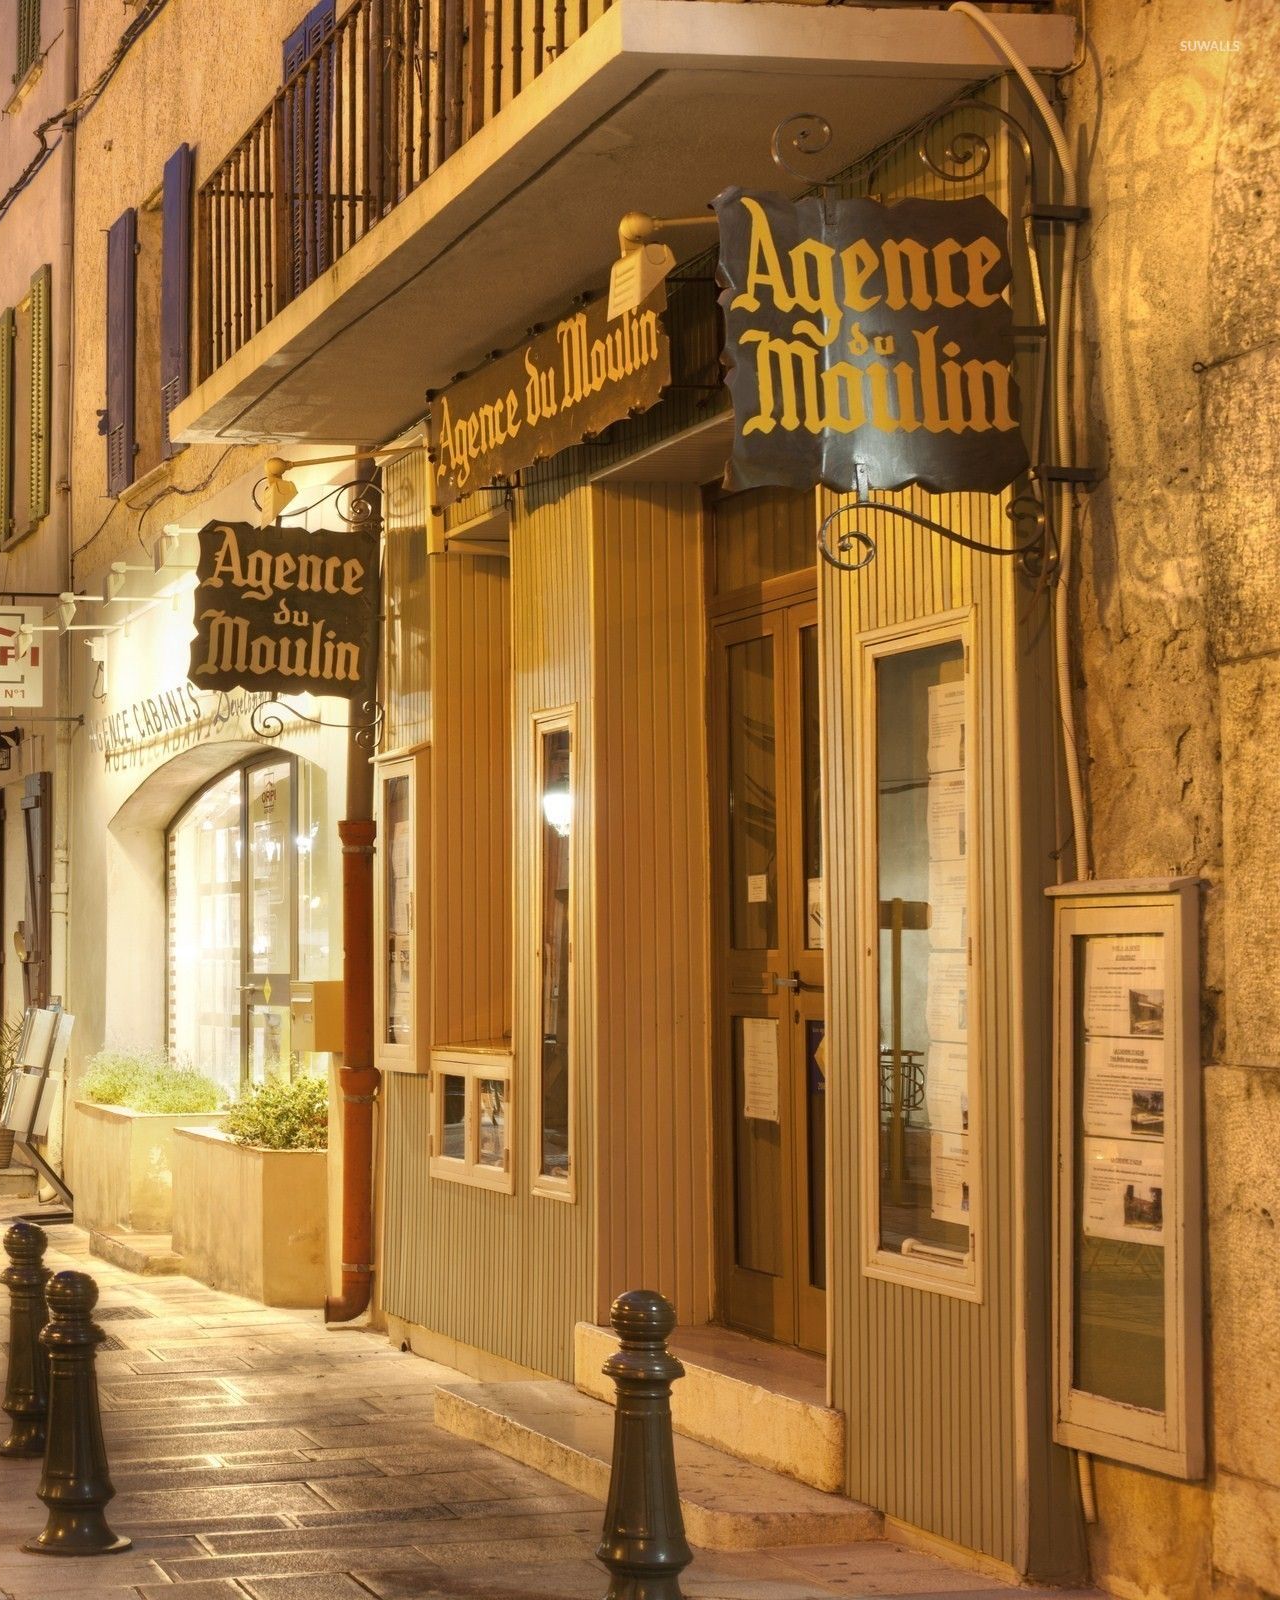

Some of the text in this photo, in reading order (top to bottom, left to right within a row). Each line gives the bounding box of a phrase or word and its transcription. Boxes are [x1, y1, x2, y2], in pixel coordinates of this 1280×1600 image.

[730, 197, 1002, 347] Agence
[848, 321, 896, 356] du
[437, 305, 659, 488] Agence du Moulin
[738, 325, 1020, 436] Moulin
[201, 526, 365, 601] Agence
[195, 608, 361, 681] Moulin
[273, 597, 310, 627] du
[132, 681, 202, 738] CABANIS
